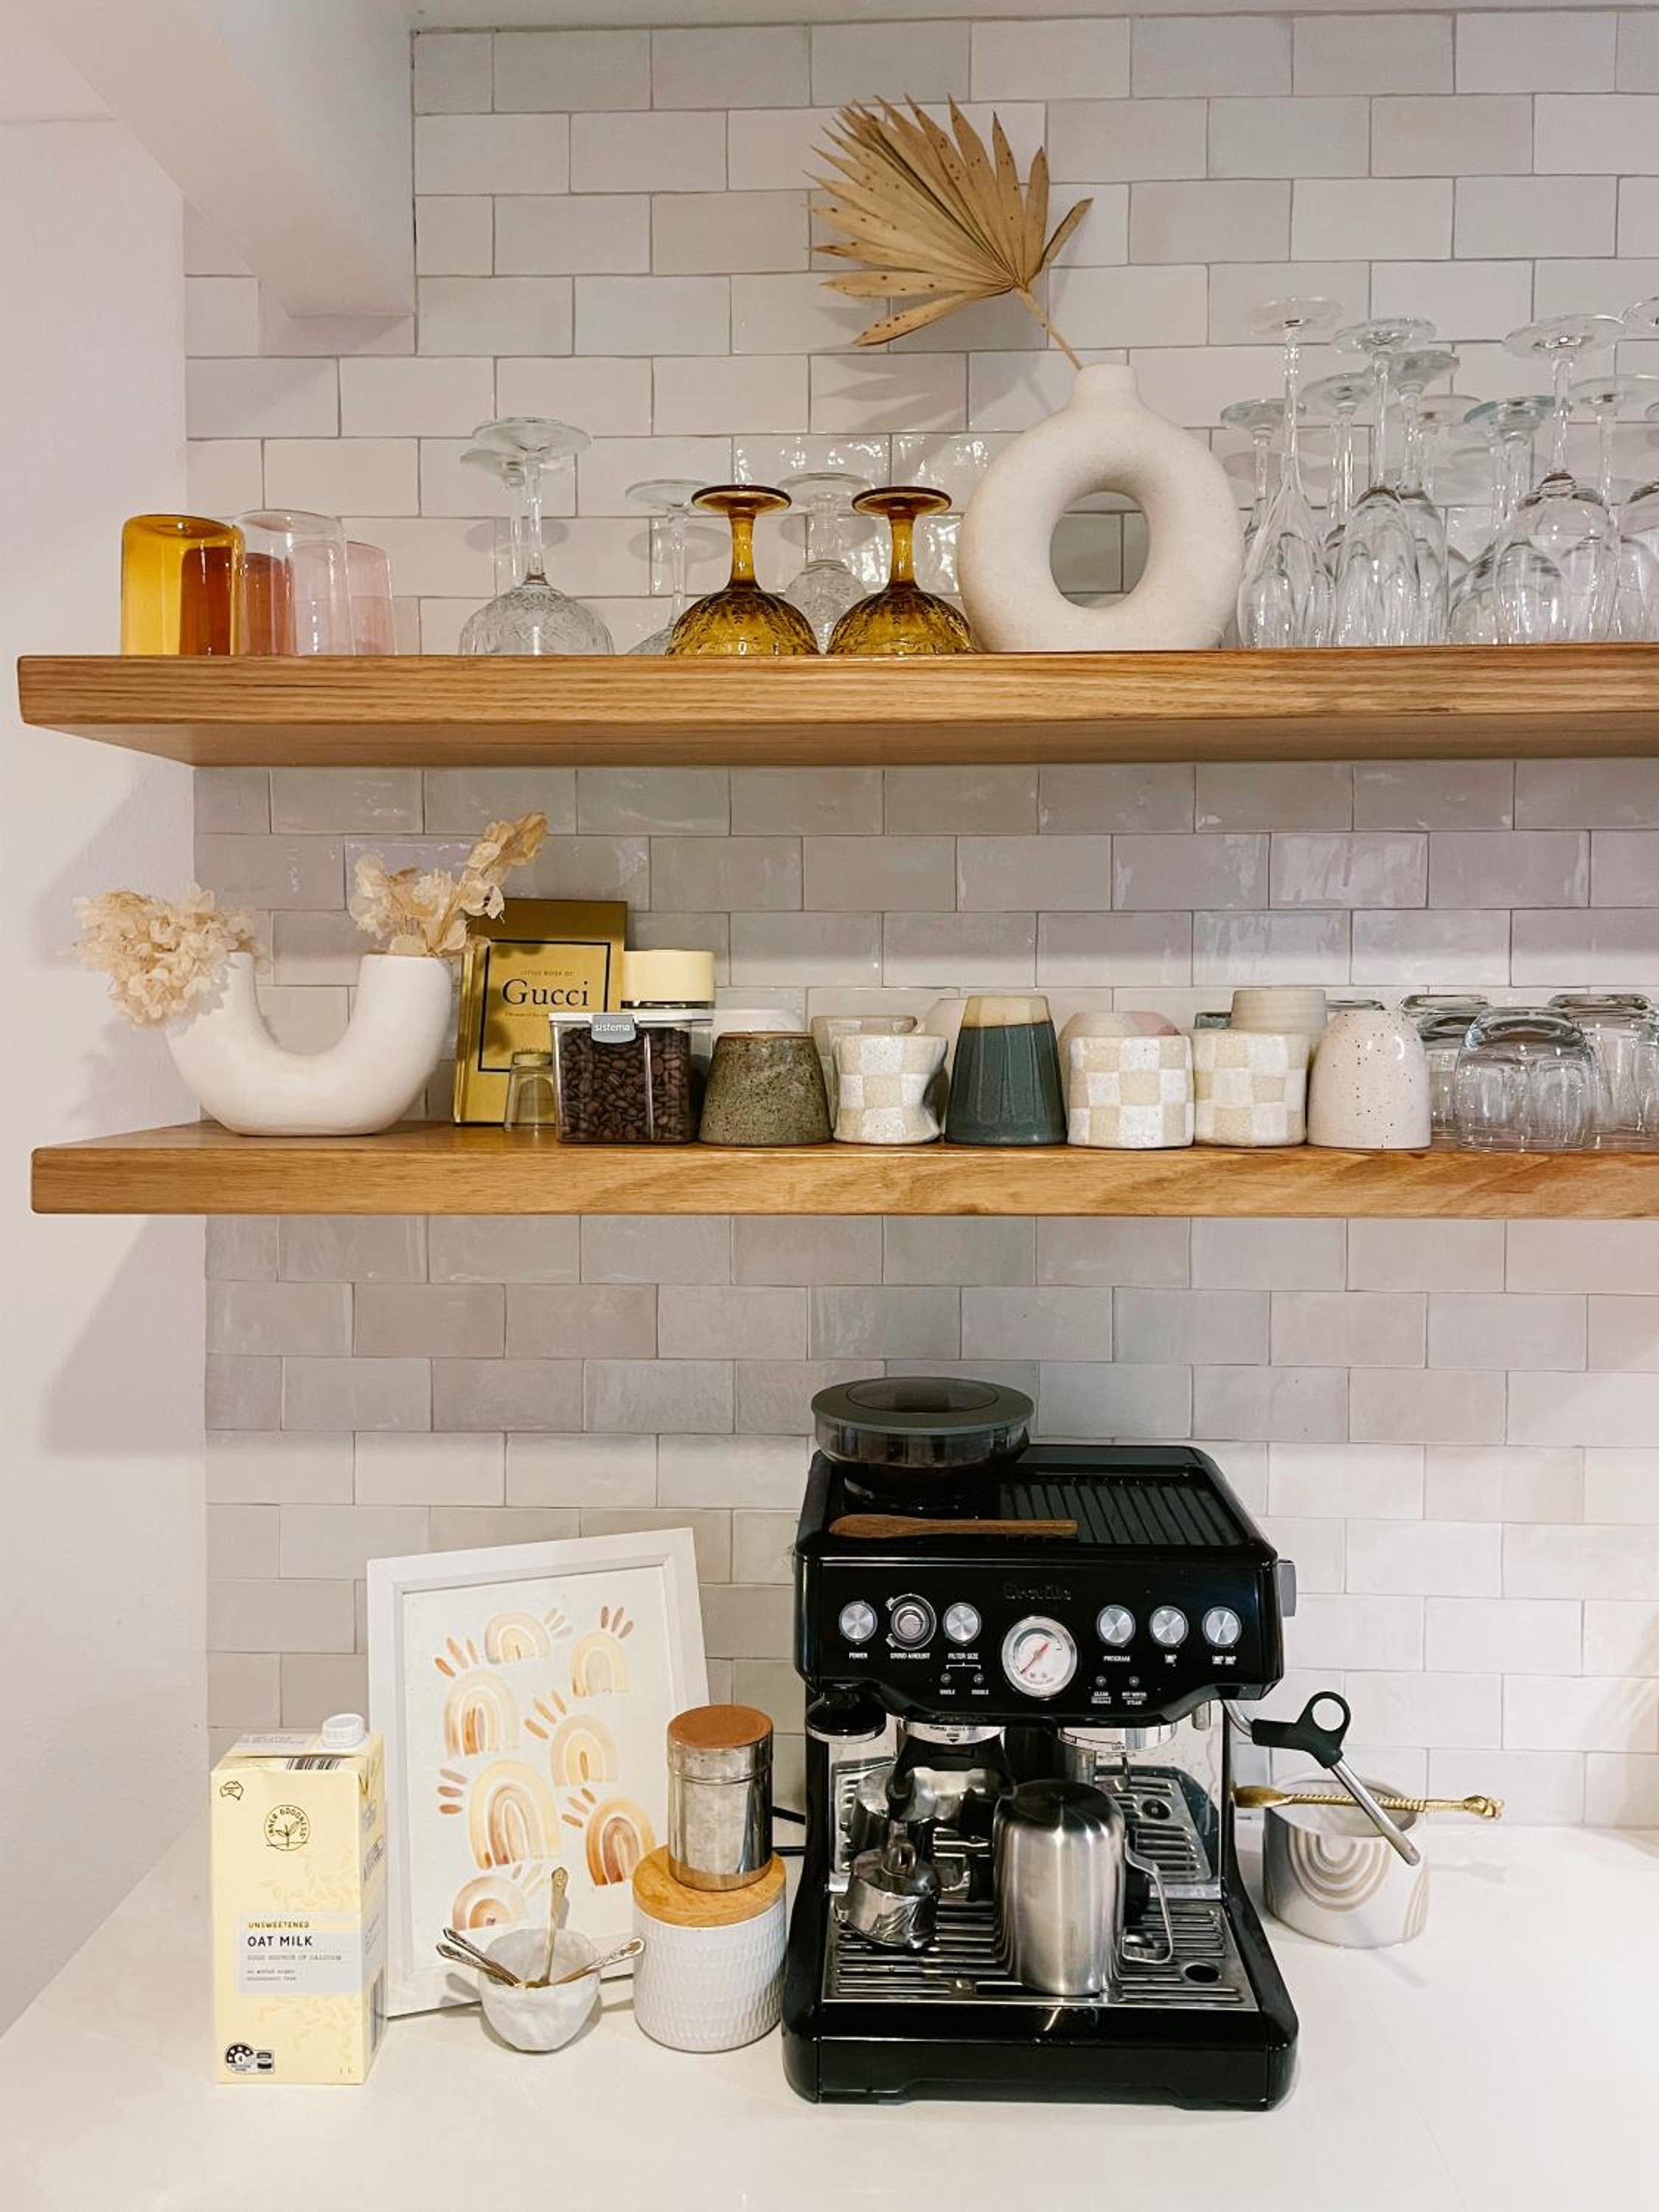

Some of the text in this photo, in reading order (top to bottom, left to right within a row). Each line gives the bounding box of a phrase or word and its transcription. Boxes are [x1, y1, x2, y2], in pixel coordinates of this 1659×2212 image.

[502, 978, 589, 1006] Gucci
[594, 1022, 630, 1032] sistema
[268, 1806, 307, 1840] INNER GOODNESS
[248, 1921, 310, 1929] UNSWEETENED
[247, 1935, 313, 1947] OAT MILK
